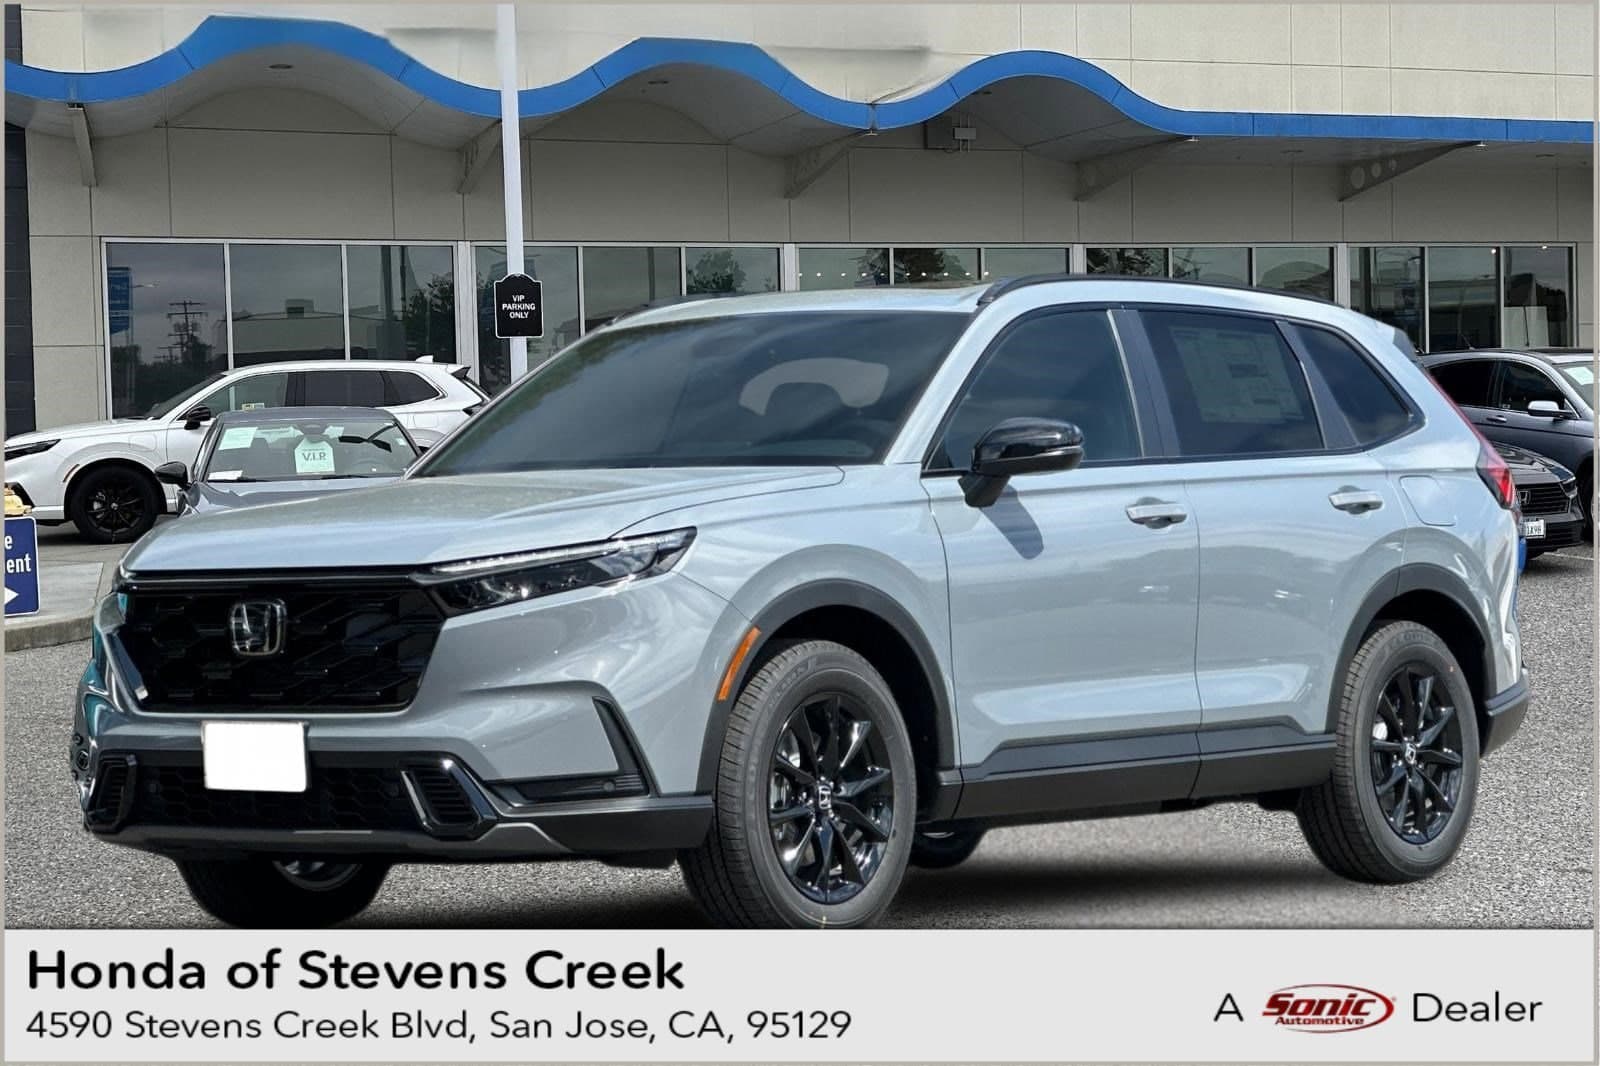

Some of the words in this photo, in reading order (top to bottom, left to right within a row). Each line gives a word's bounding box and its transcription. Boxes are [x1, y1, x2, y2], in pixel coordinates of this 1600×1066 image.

[512, 294, 525, 302] VIP
[502, 303, 536, 311] PARKING
[509, 311, 529, 319] ONLY
